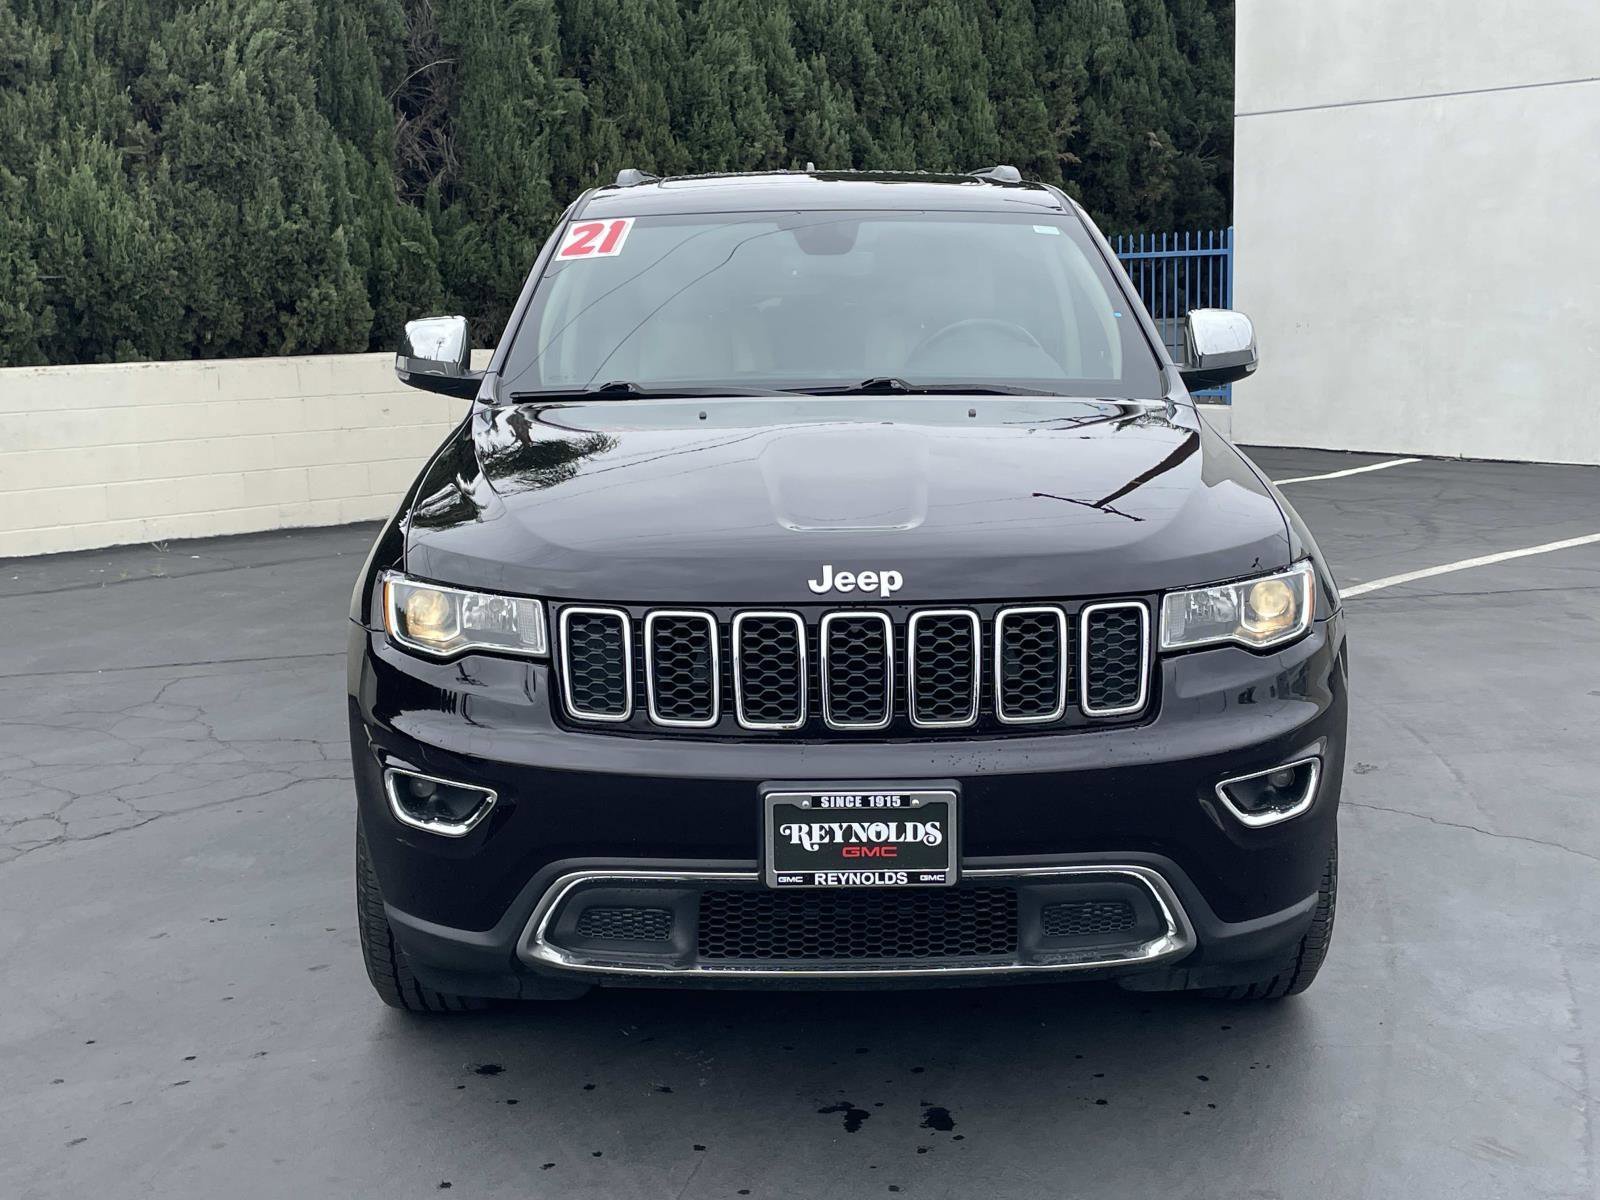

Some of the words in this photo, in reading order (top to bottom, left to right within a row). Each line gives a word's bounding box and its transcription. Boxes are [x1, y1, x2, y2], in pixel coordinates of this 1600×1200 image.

[561, 220, 626, 256] 21
[808, 565, 903, 598] Jeep
[821, 796, 862, 808] SINCE
[868, 795, 901, 807] 1915
[780, 821, 942, 852] REYNOLDS
[842, 846, 897, 858] GMC
[814, 872, 908, 885] REYNOLDS
